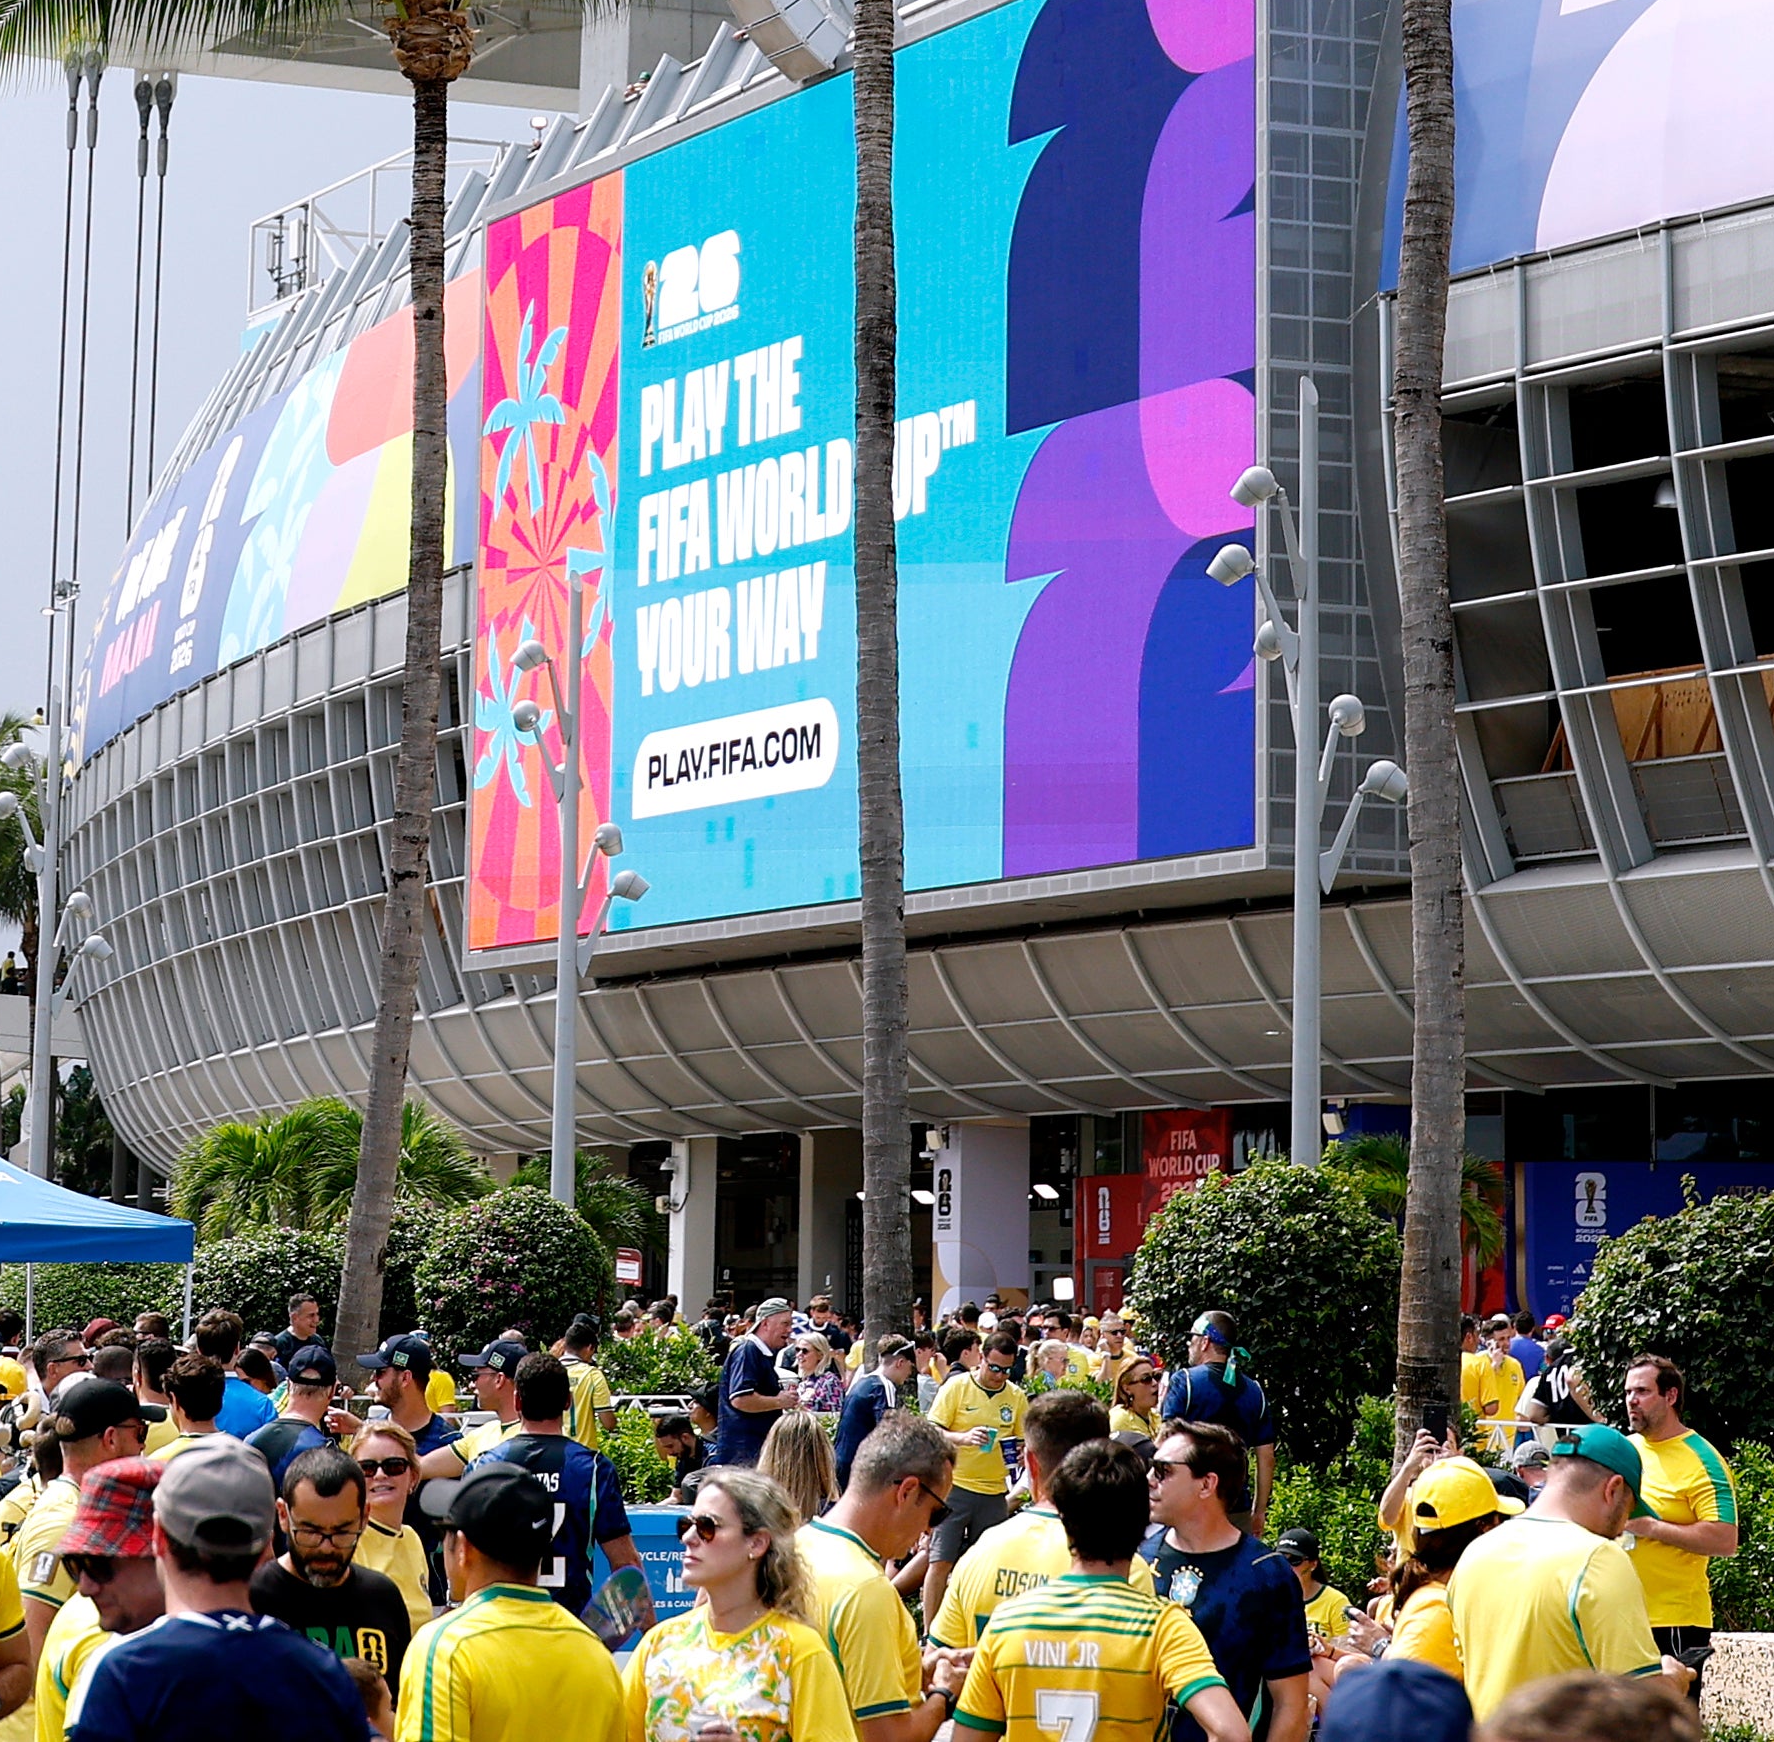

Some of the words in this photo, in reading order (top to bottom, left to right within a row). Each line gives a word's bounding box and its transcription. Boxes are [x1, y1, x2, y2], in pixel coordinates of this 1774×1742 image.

[640, 359, 730, 477] PLAY
[734, 335, 802, 447] THE
[637, 478, 711, 587] FIFA
[716, 438, 853, 565] WORLD
[893, 399, 976, 521] UP™
[636, 586, 731, 697] YOUR
[736, 560, 826, 675] WAY
[648, 723, 821, 789] PLAY.FIFA.COM
[1170, 1130, 1197, 1151] FIFA
[1149, 1155, 1193, 1177] WORLD
[1194, 1153, 1220, 1175] CUP
[1575, 1234, 1600, 1243] 202
[1546, 1364, 1569, 1402] 10
[532, 1473, 560, 1492] TAS
[994, 1568, 1050, 1597] EDSON
[1024, 1640, 1068, 1667] VINI
[1073, 1641, 1101, 1668] JR
